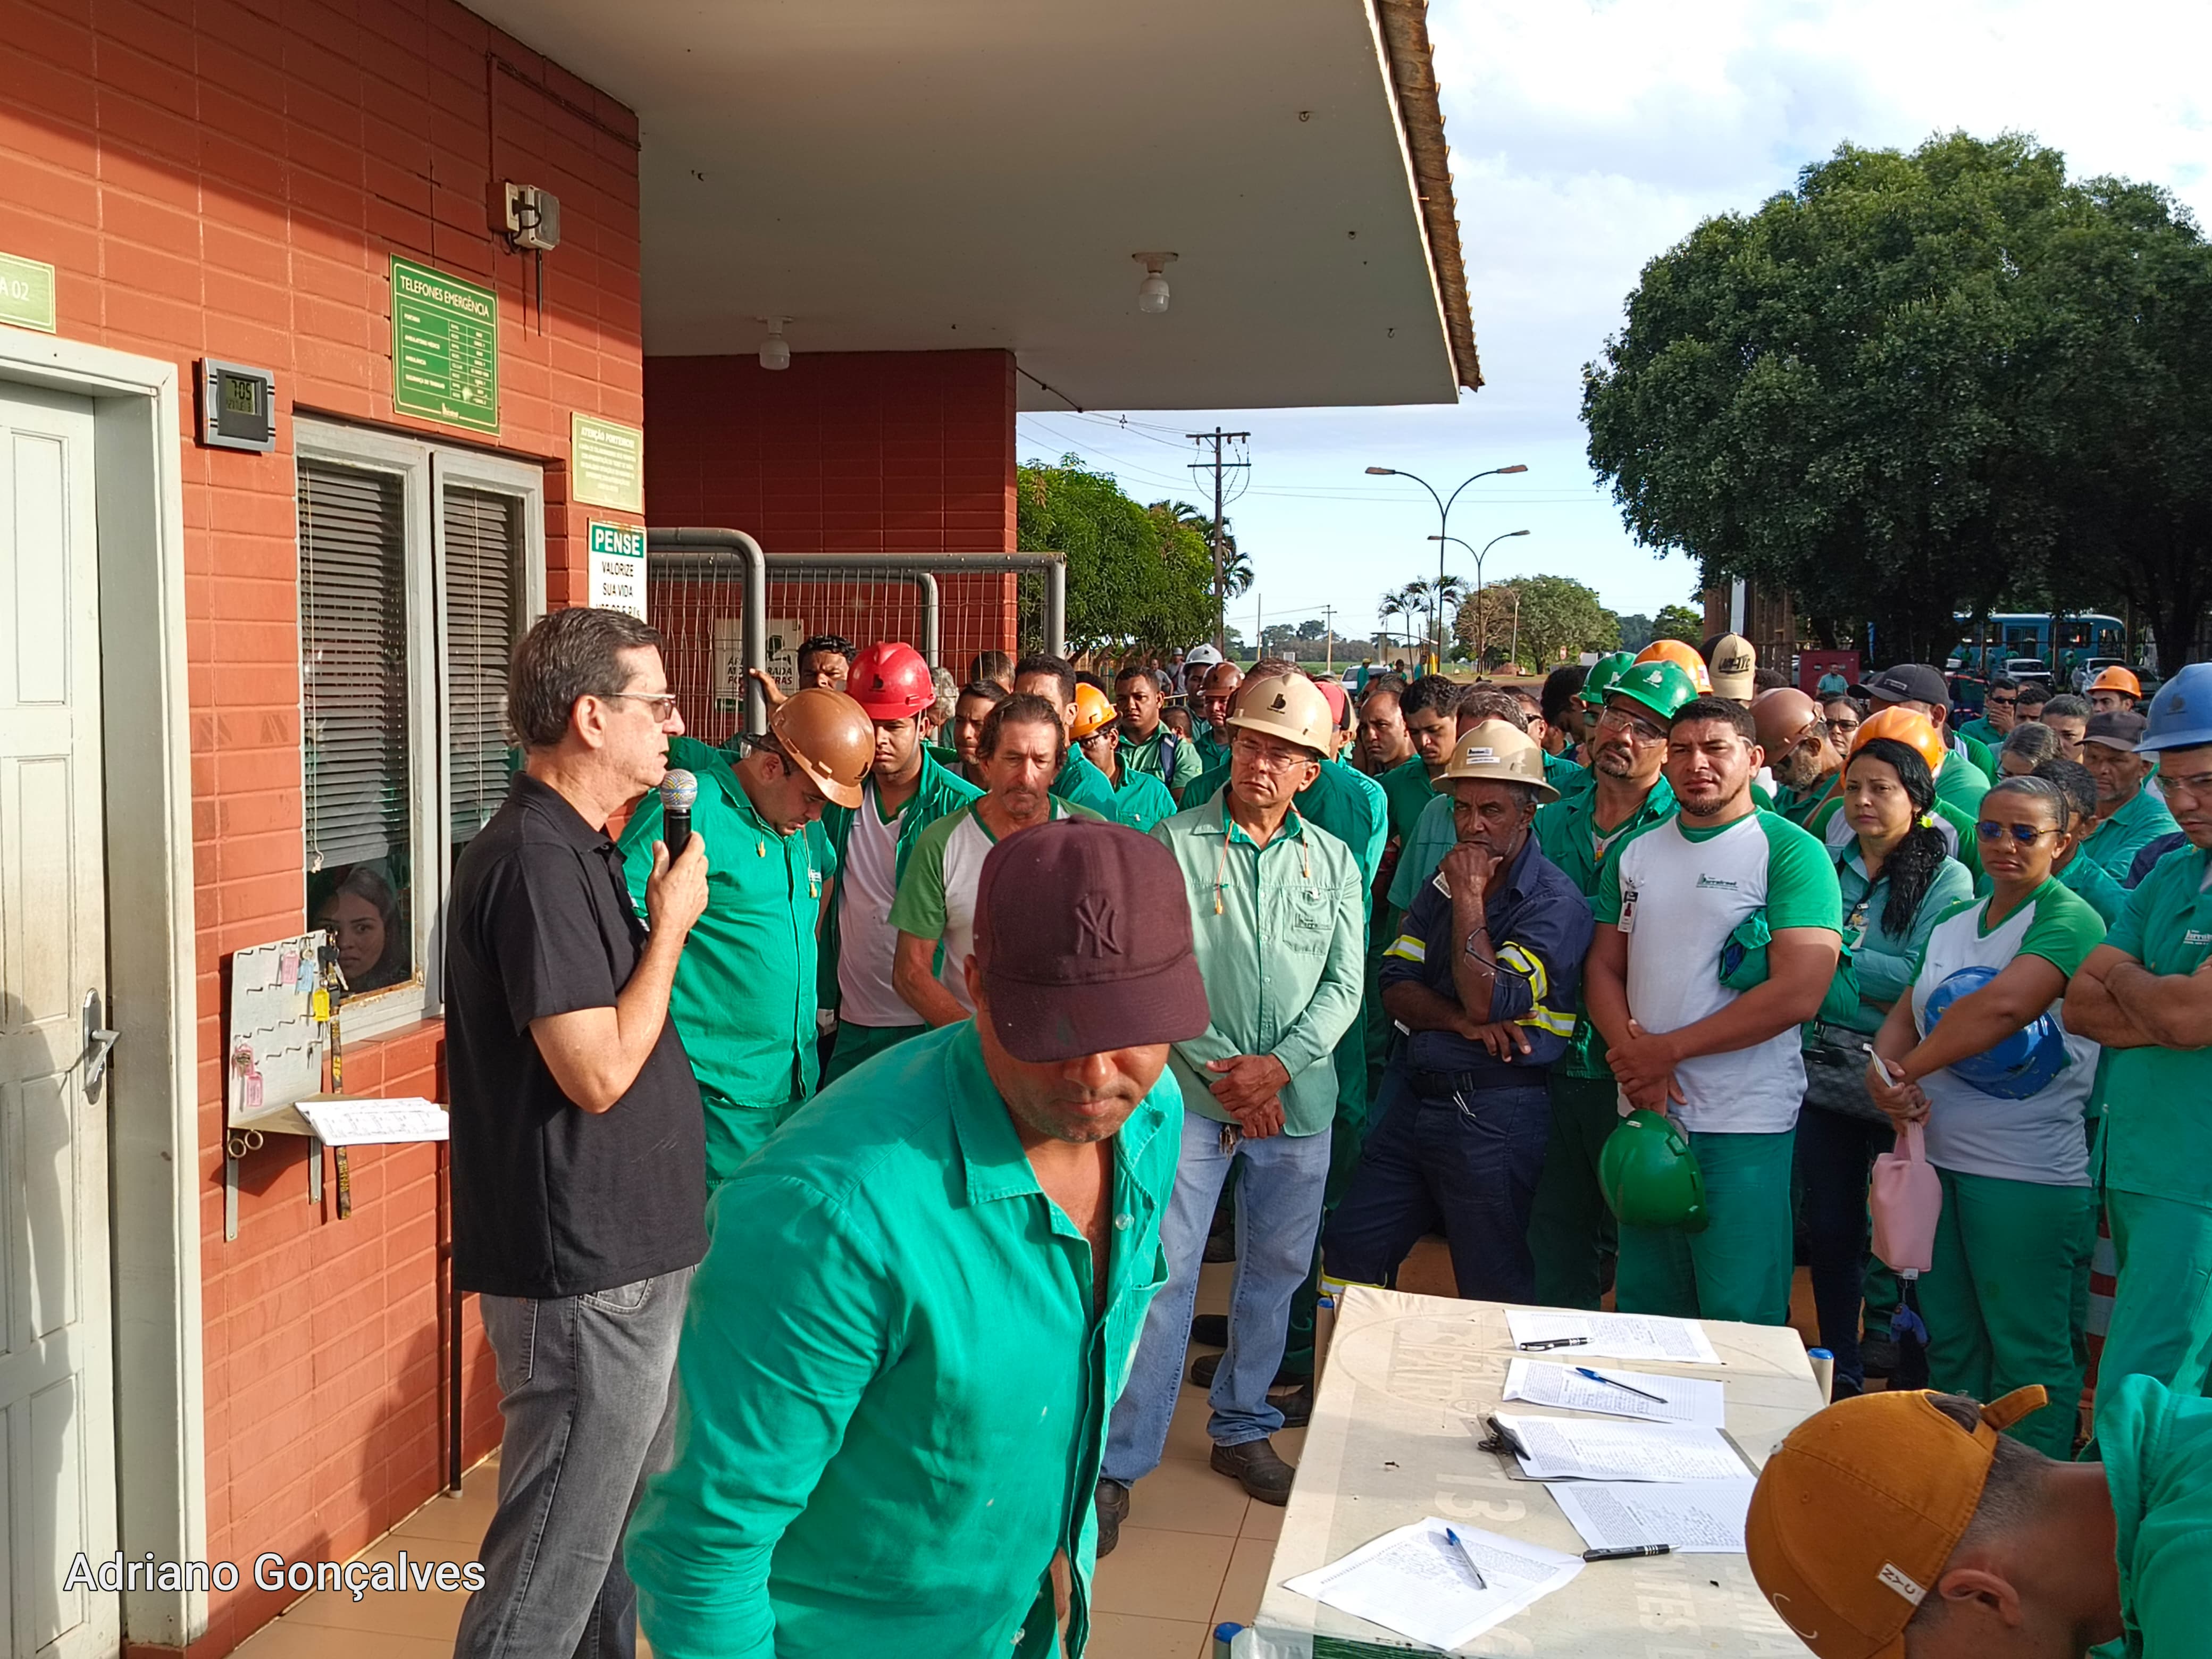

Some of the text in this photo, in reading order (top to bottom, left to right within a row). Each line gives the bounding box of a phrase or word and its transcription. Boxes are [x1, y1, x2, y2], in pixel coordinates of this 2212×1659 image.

[12, 280, 30, 301] 02
[400, 275, 489, 318] TELEFONES EMERGÊNCIA
[595, 529, 641, 556] PENSE
[601, 561, 634, 577] VALORIZE
[602, 582, 634, 598] SUA VIDA
[1076, 897, 1123, 958] NY
[1435, 1464, 1527, 1522] 13
[1882, 1567, 1915, 1595] NYC
